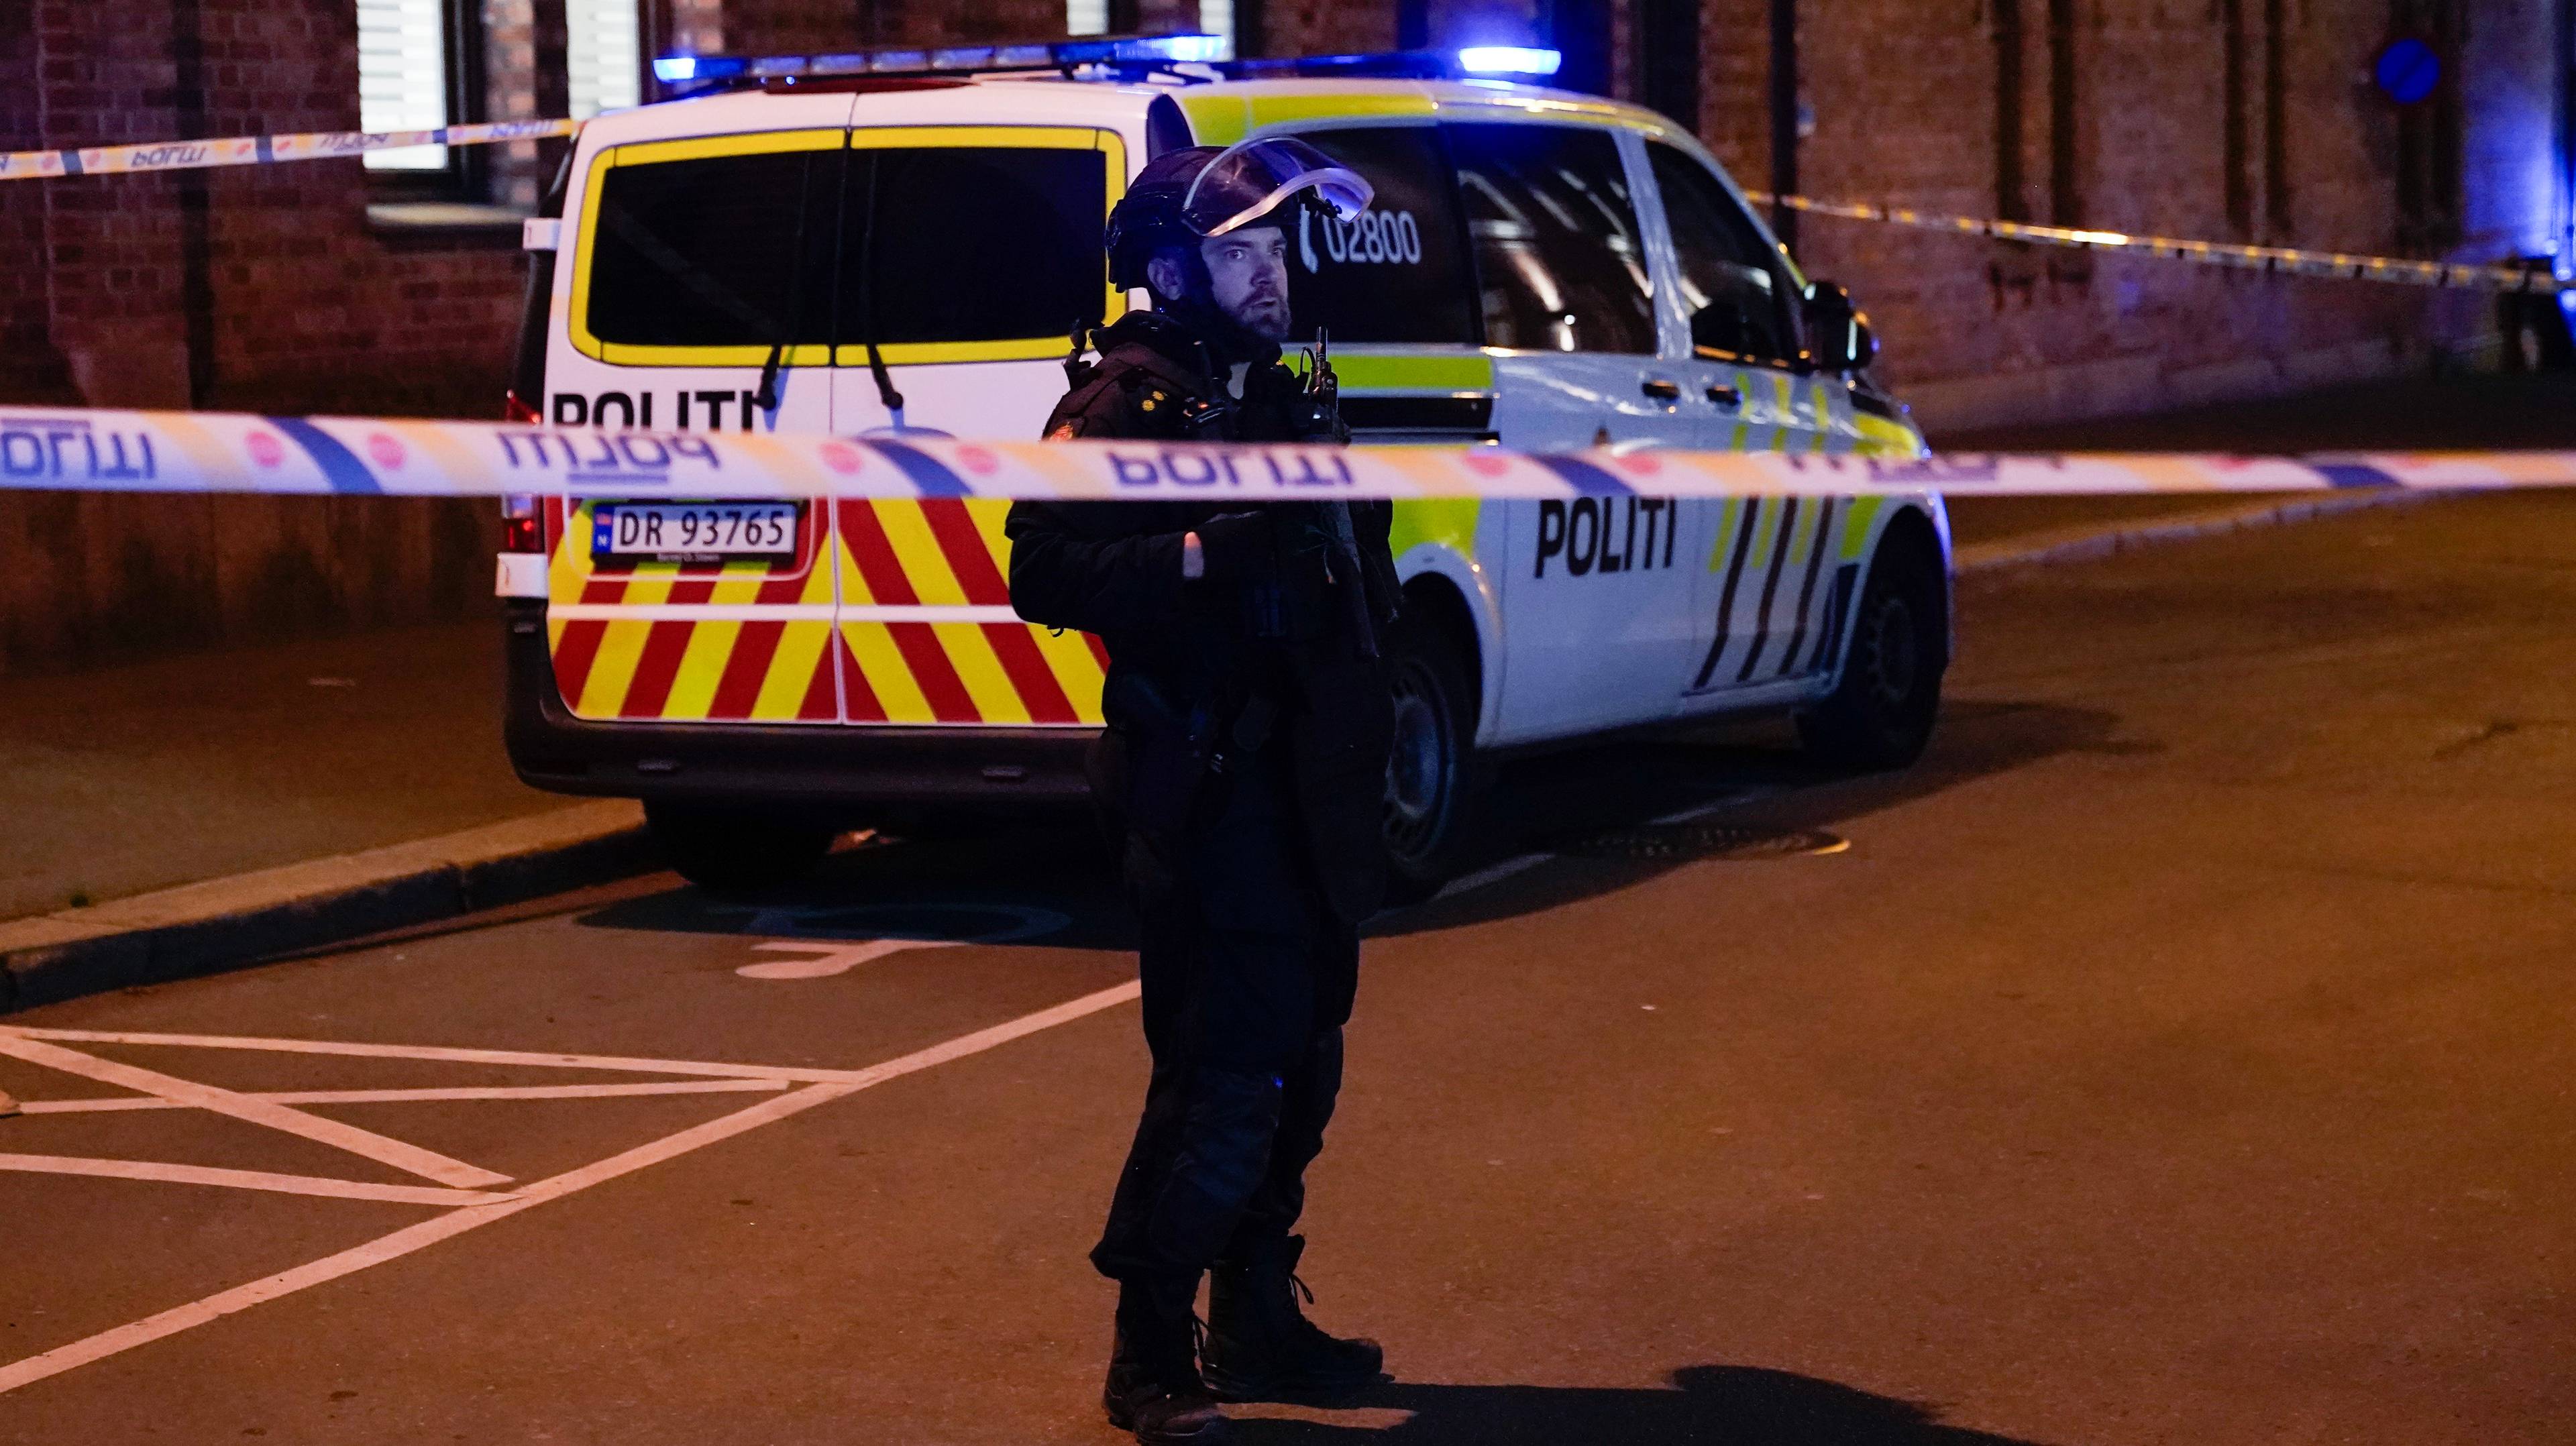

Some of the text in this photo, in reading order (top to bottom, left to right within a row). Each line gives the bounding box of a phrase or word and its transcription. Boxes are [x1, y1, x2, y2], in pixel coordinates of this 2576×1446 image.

[1322, 209, 1422, 264] 02800
[619, 510, 785, 547] DR 93765
[1534, 496, 1677, 579] POLITI
